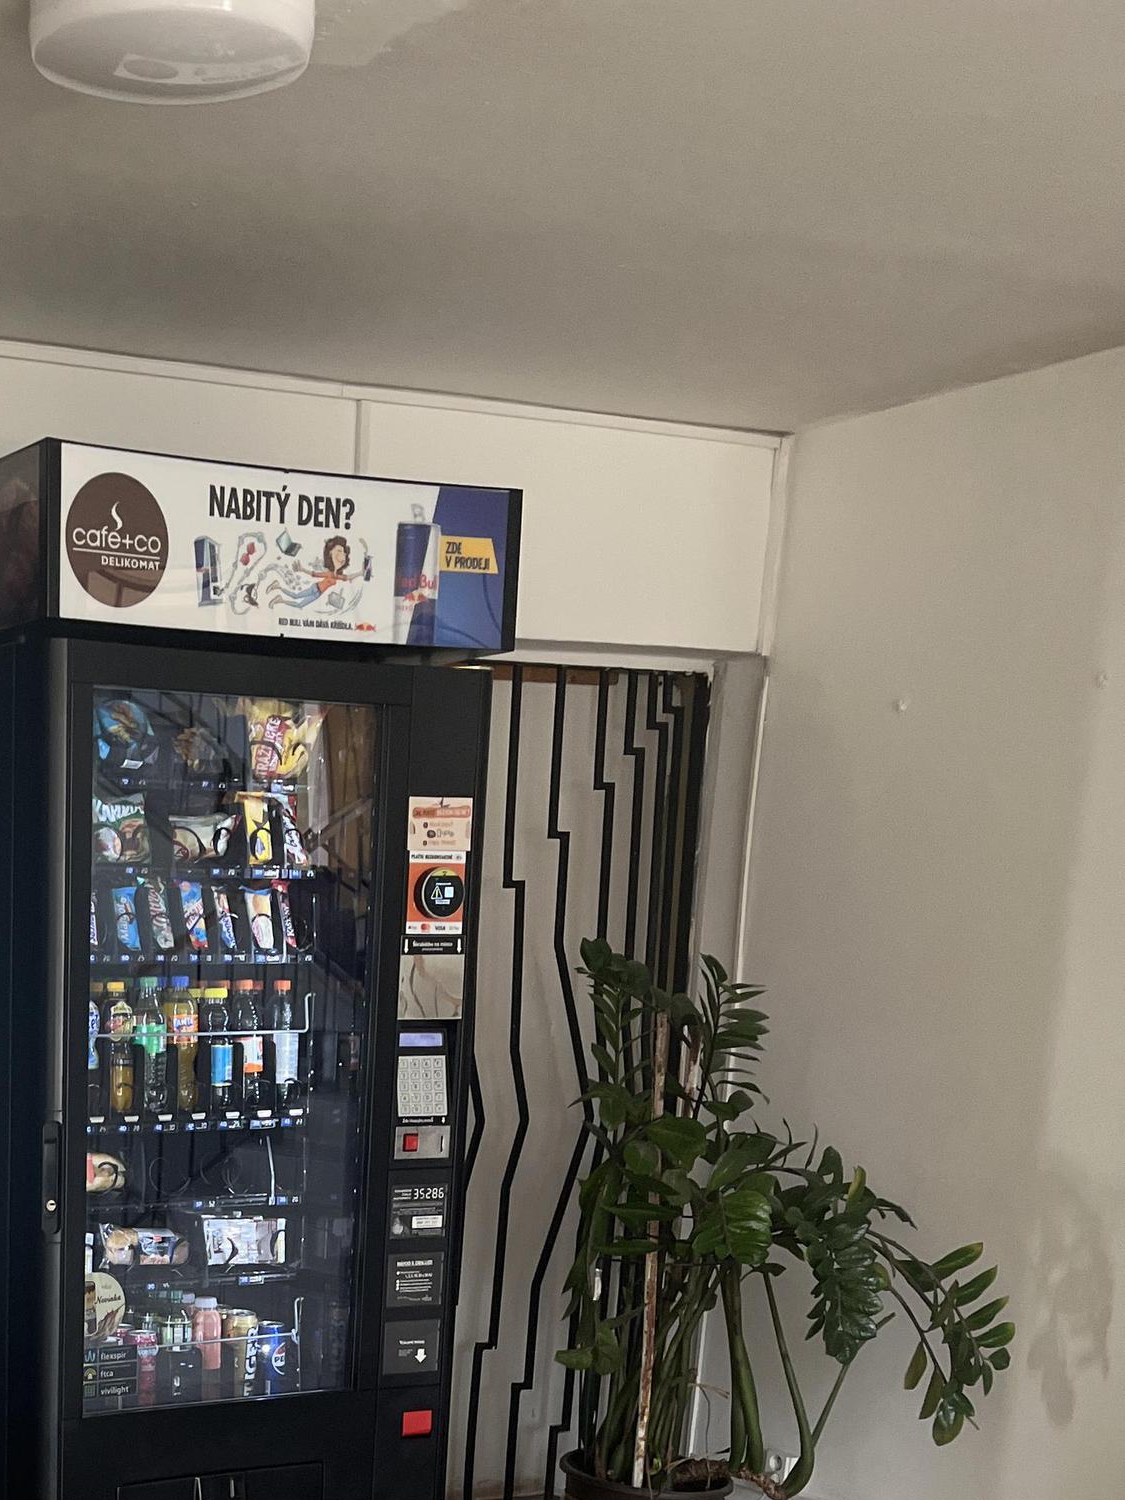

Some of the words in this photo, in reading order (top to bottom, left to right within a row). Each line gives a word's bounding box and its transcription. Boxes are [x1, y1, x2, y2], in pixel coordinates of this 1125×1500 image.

[209, 484, 291, 524] NABITÝ
[297, 494, 355, 530] DEN?
[445, 541, 462, 555] ZDE
[101, 555, 161, 571] DELIKOMAT
[445, 556, 452, 568] V
[454, 556, 490, 571] PRODEJI
[413, 1187, 445, 1200] 35286
